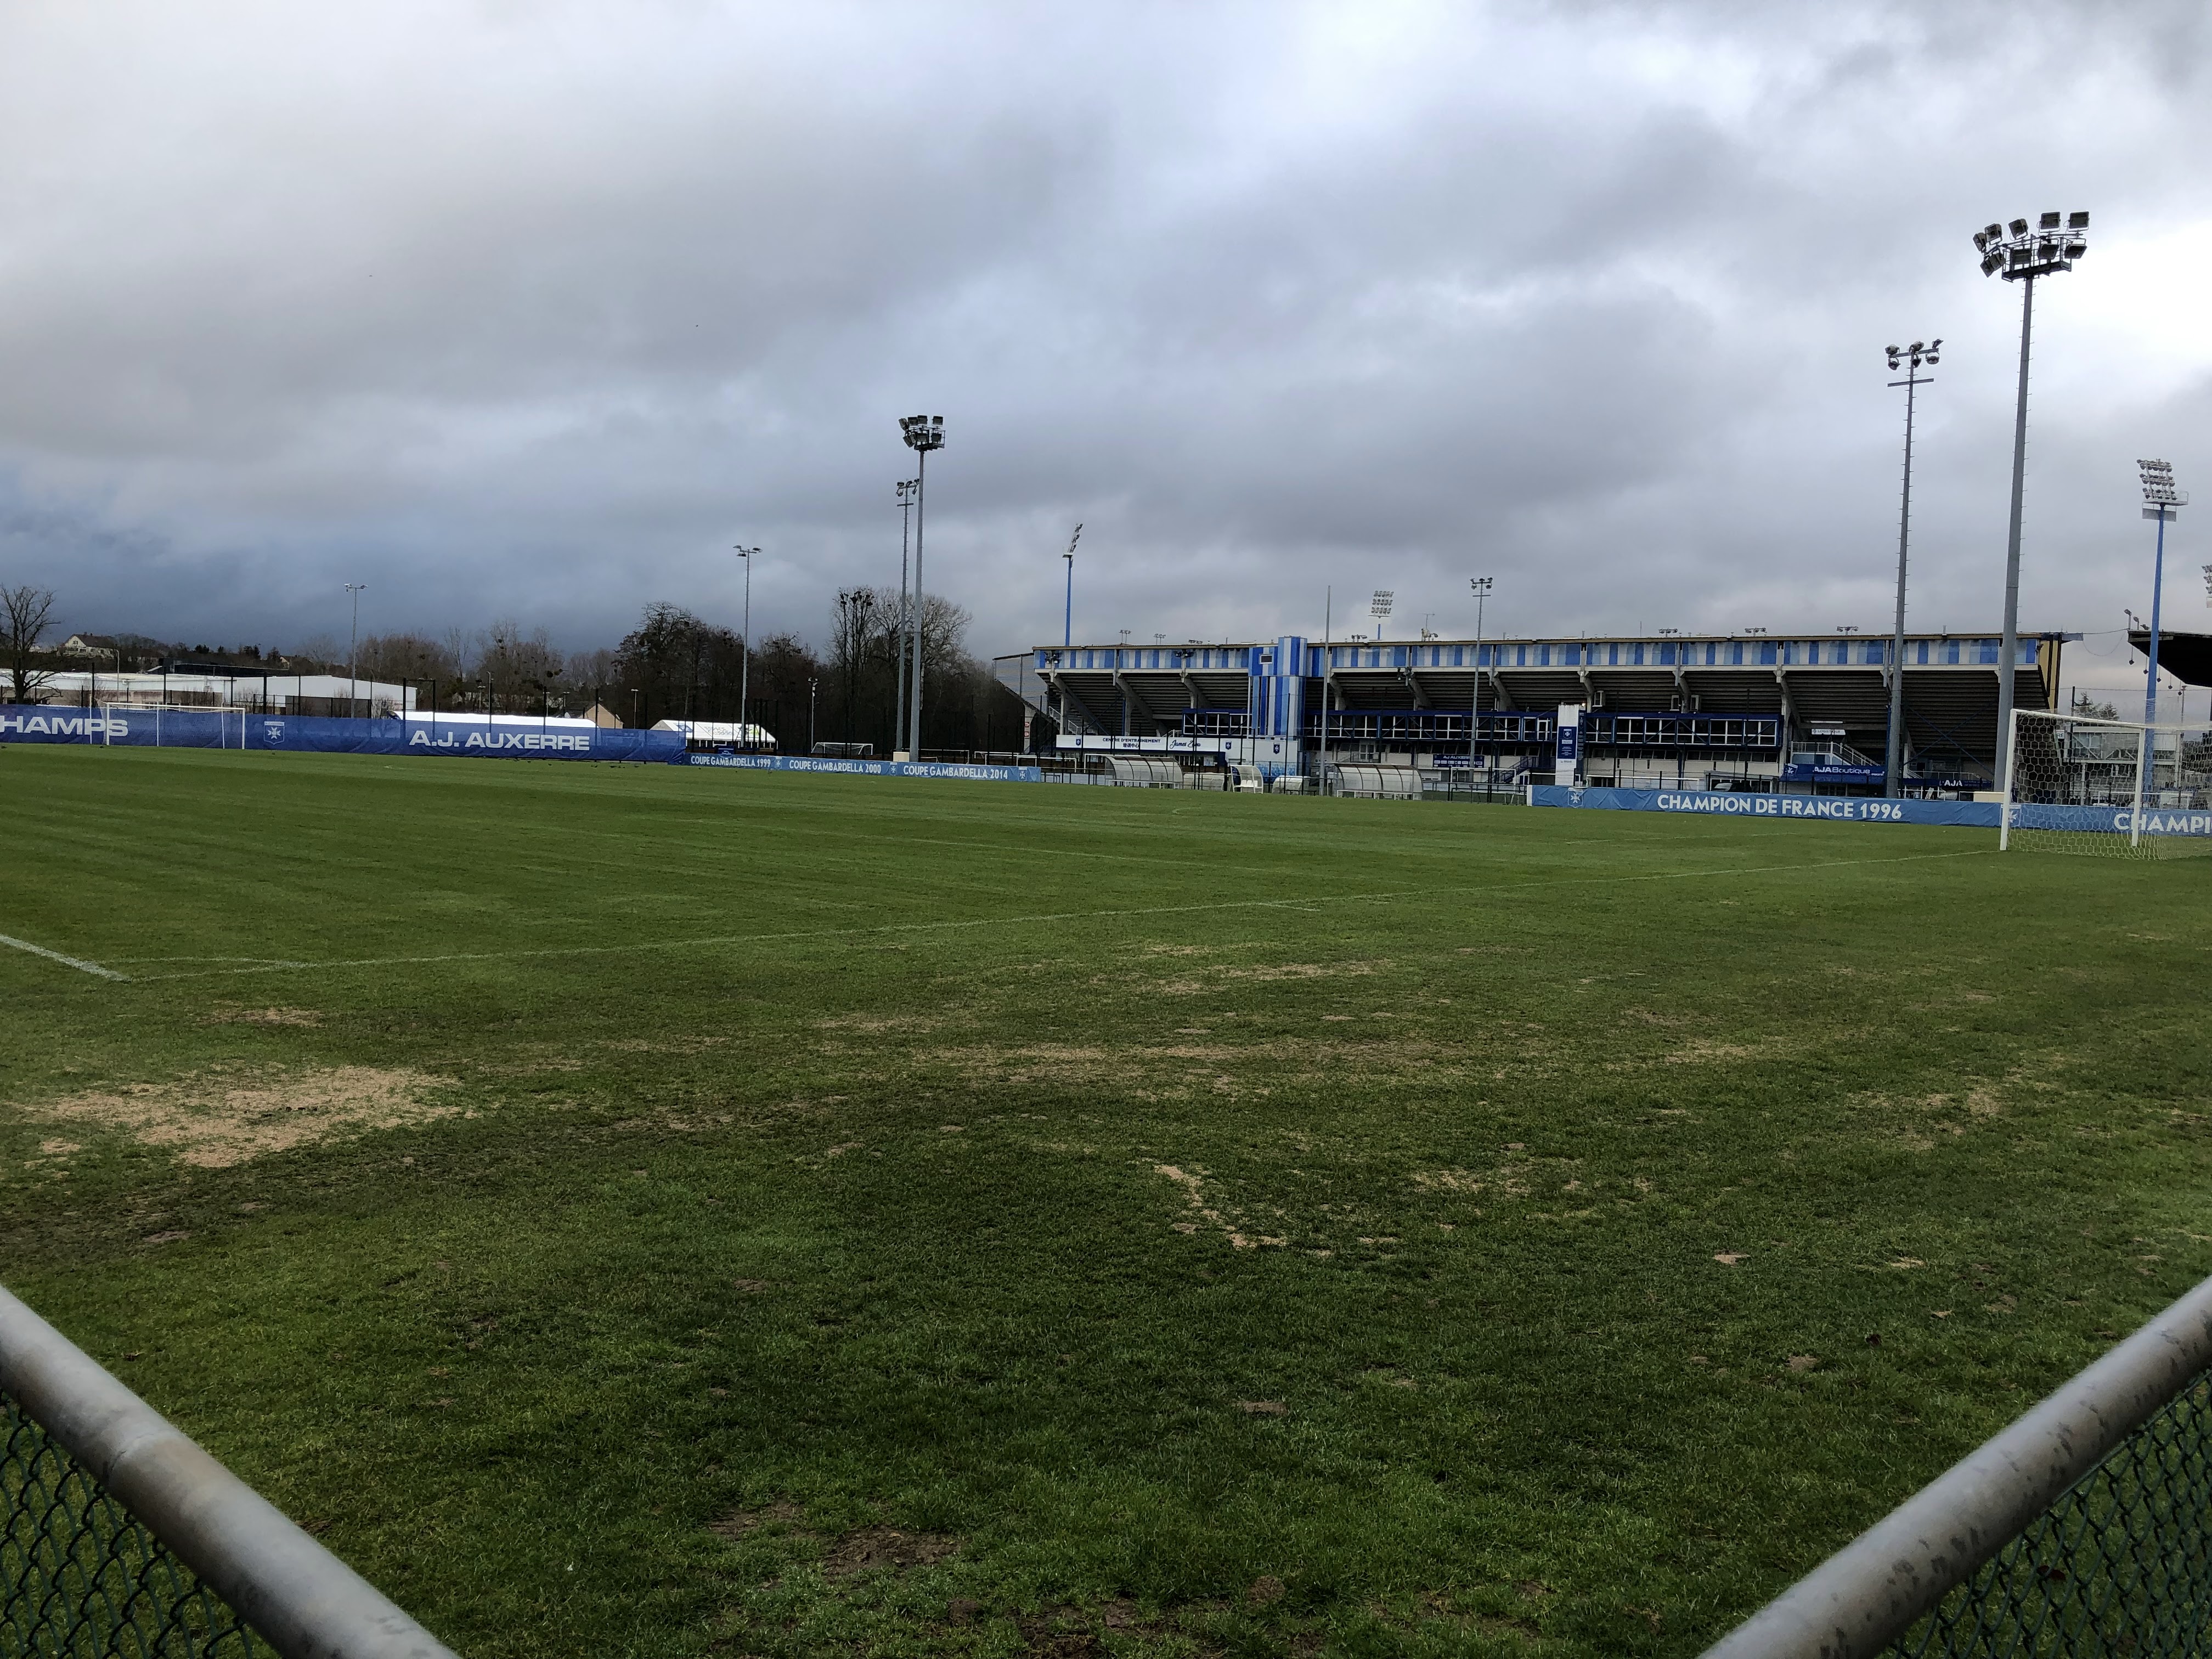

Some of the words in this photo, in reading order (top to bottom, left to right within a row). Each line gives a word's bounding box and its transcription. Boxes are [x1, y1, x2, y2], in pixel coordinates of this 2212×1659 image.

[0, 715, 128, 736] HAMPS
[409, 730, 459, 747] A.J.
[464, 732, 590, 751] AUXERRE
[691, 755, 710, 765] COUPE
[711, 757, 755, 766] GAMBARDELLA
[757, 758, 771, 768] 1999
[789, 760, 811, 770] COUPE
[812, 761, 864, 773] GAMBARDELLA
[865, 764, 881, 774] 2000
[903, 765, 928, 776] COUPE
[929, 766, 988, 778] GAMBARDELLA
[990, 769, 1008, 780] 2014
[1657, 794, 1751, 812] CHAMPION
[1756, 799, 1777, 814] DE
[1782, 800, 1854, 817] FRANCE
[1860, 803, 1902, 820] 1996
[2114, 813, 2212, 834] CHAMPI
